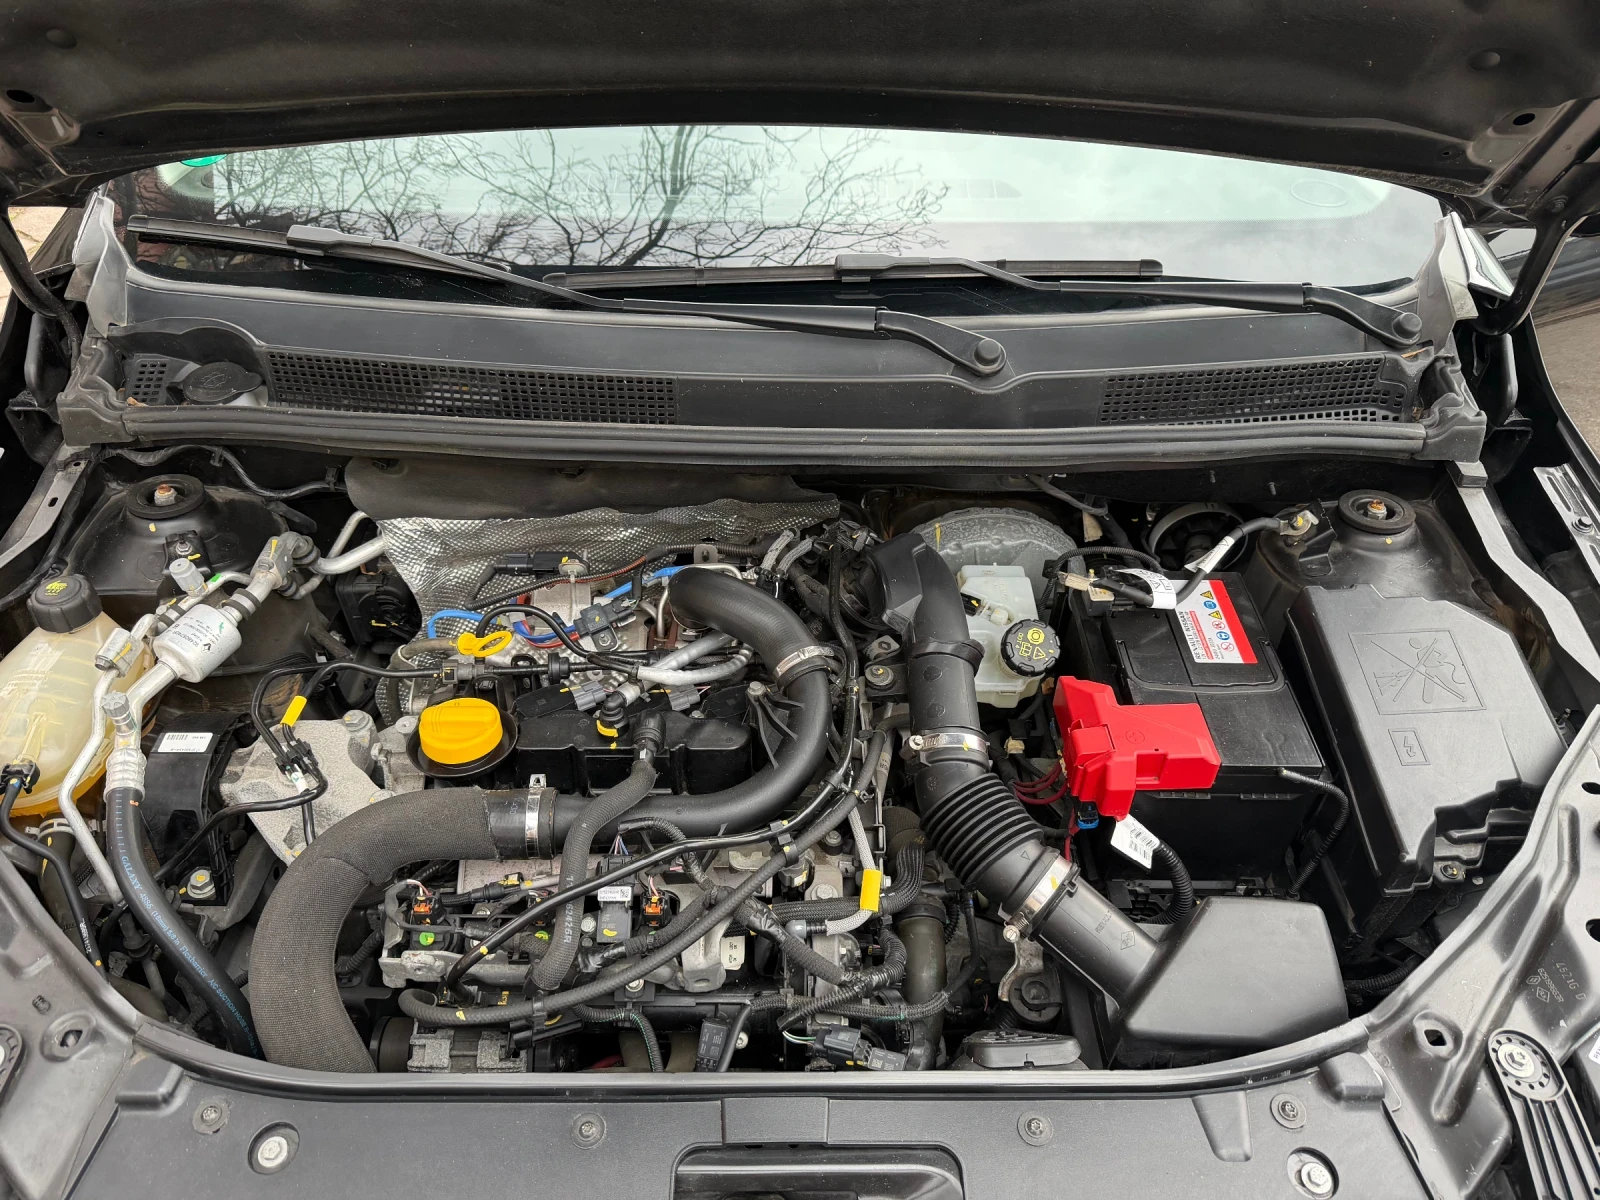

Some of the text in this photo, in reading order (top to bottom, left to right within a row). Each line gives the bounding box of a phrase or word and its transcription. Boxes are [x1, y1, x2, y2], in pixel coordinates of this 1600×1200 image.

[1178, 611, 1191, 632] NISSAN
[1187, 634, 1202, 660] RENAULT
[121, 856, 143, 890] GALAXY
[216, 988, 237, 1013] SUCTION
[234, 1010, 247, 1028] HOSE
